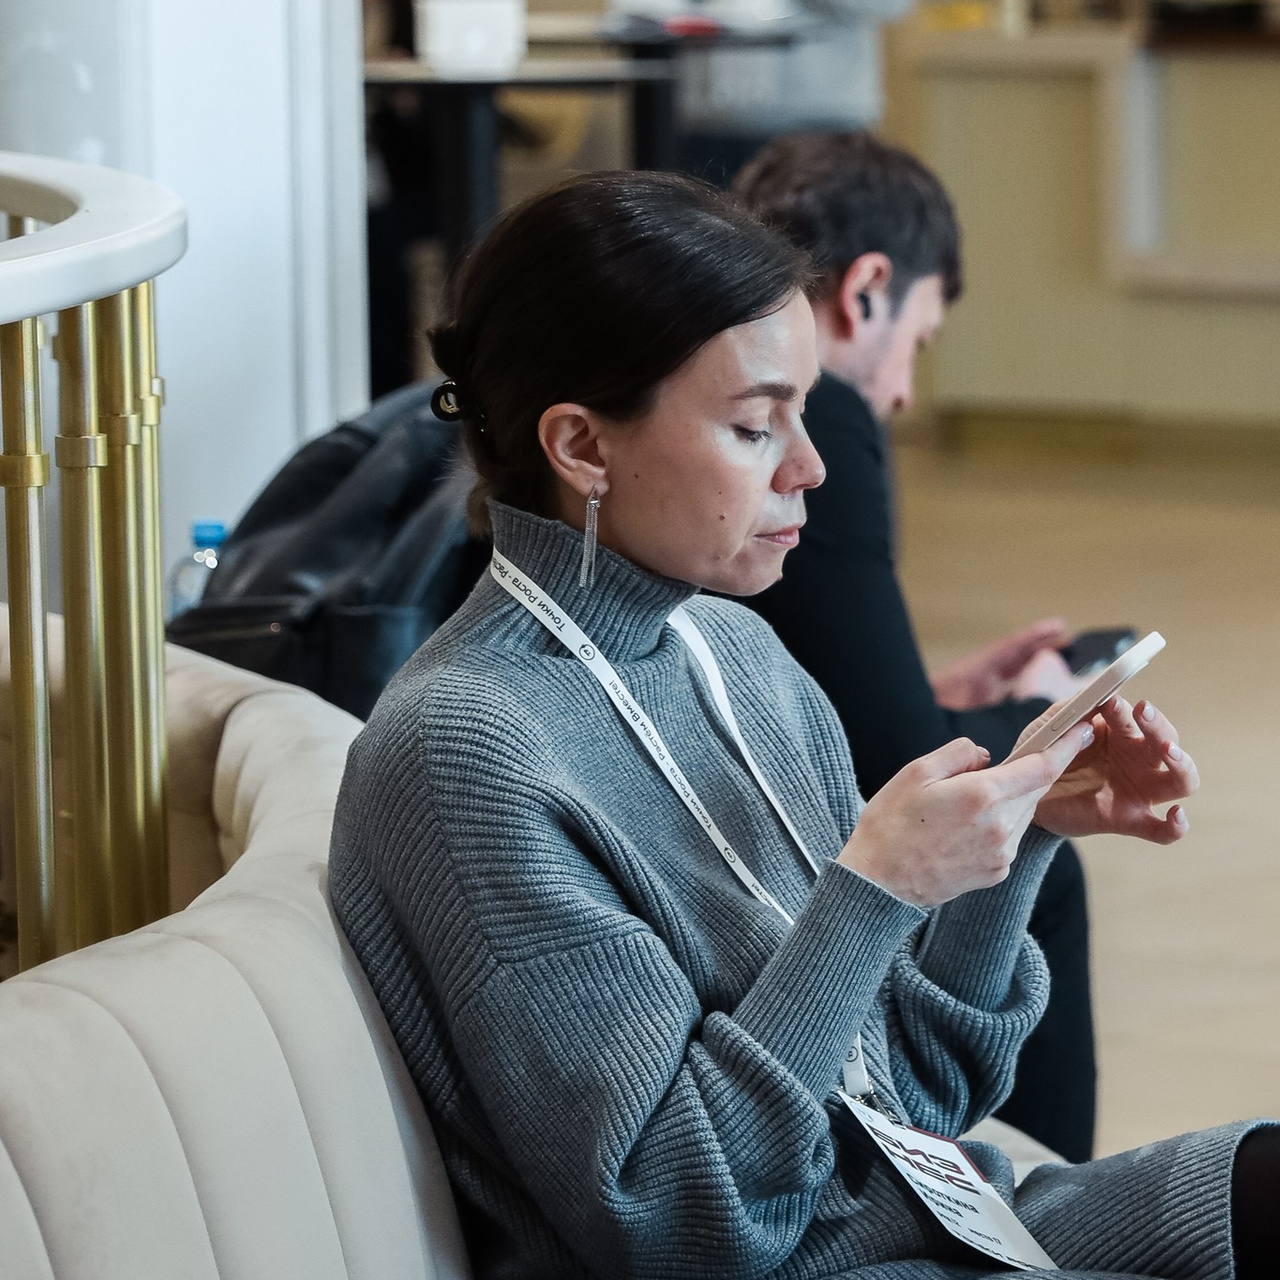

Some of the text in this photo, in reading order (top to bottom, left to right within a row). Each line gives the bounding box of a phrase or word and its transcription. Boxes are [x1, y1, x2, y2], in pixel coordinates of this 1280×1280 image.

[511, 577, 538, 603] Роста
[537, 600, 566, 632] Точки
[608, 680, 641, 722] Вместе!
[669, 767, 691, 799] Роста
[690, 798, 713, 831] Точки
[865, 1122, 965, 1175] БИЗ
[881, 1142, 982, 1196] НЕС
